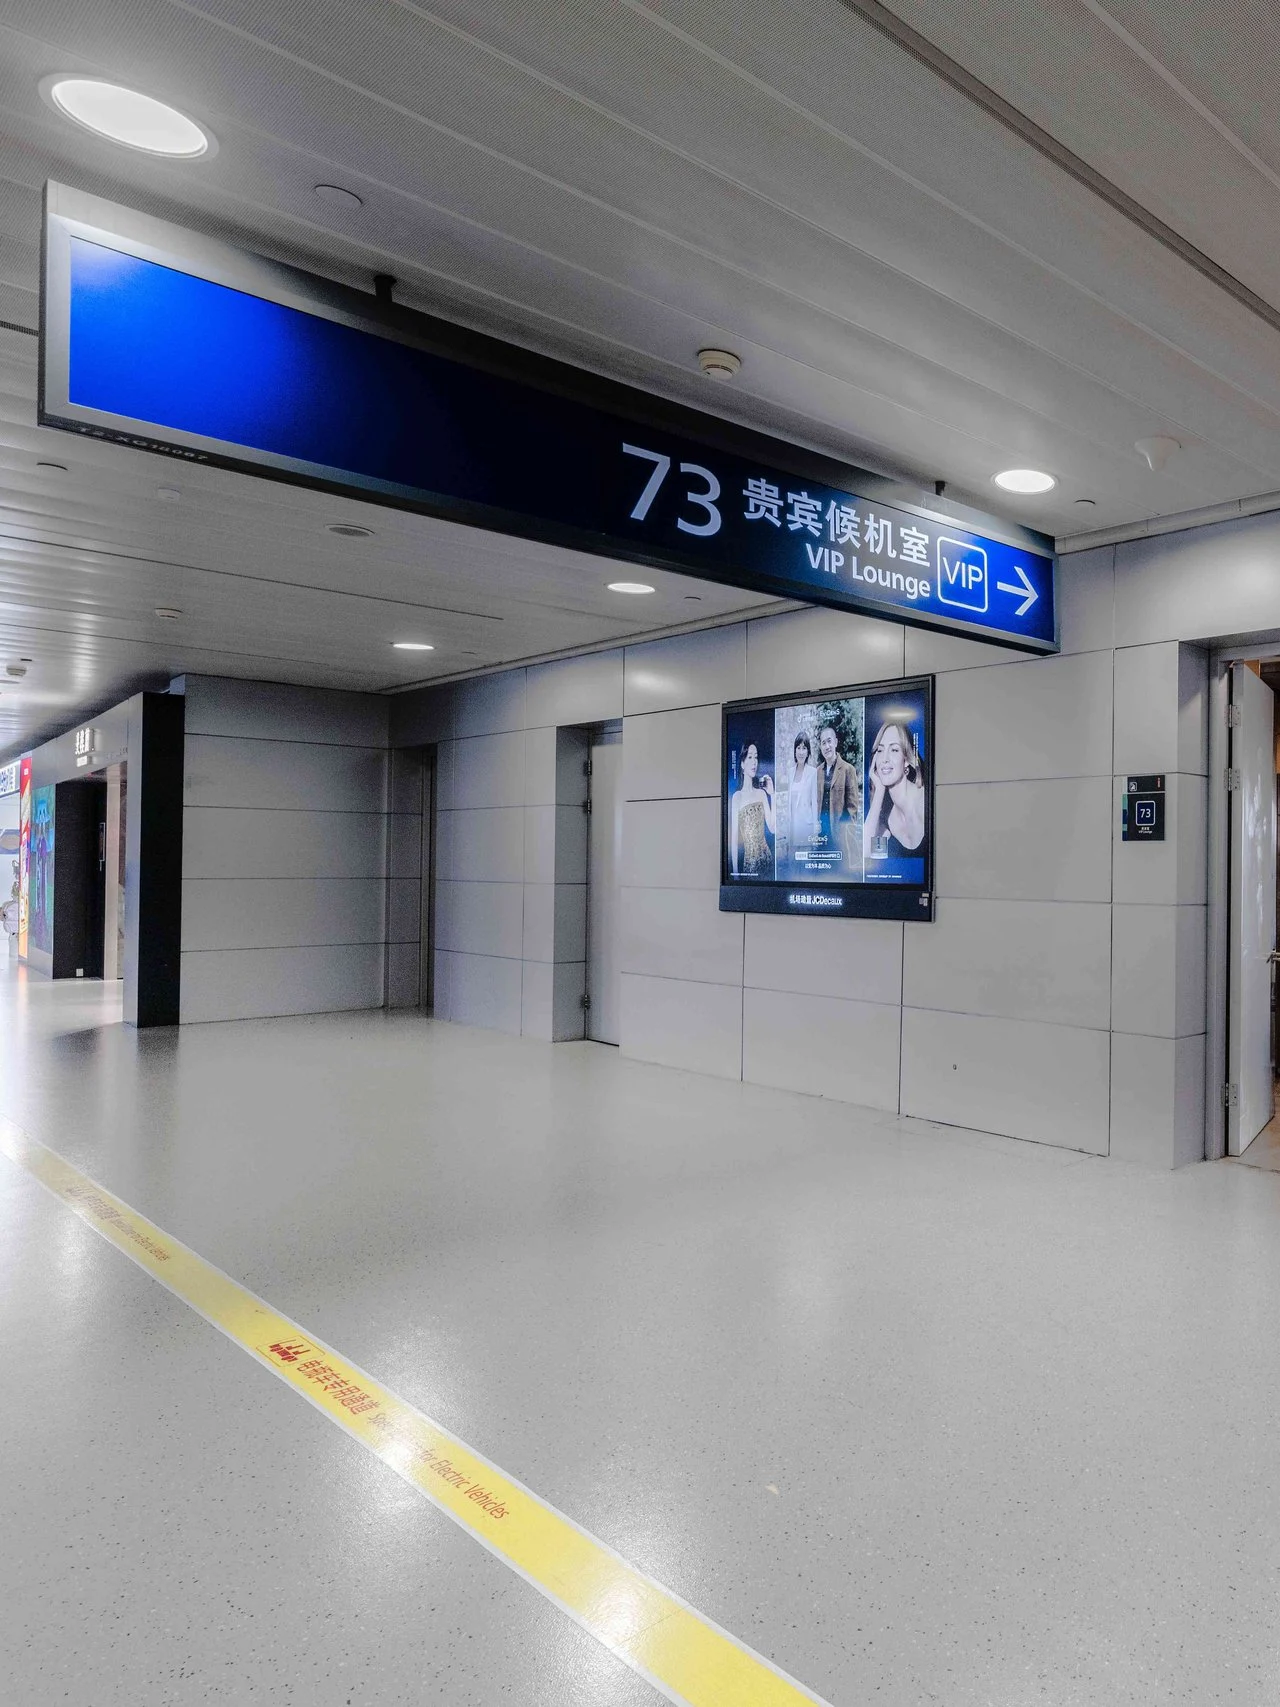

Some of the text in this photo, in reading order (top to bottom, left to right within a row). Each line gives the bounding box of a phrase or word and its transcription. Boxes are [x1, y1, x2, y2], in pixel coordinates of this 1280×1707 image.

[622, 442, 931, 567] 73 贵宾候机室
[805, 543, 983, 600] VIP Lounge VIP
[1140, 808, 1151, 818] 73
[812, 894, 843, 906] JCDecaux
[297, 1359, 380, 1415] 电瓶车专用通道
[429, 1459, 470, 1489] Electric
[463, 1483, 510, 1520] Vehicles
